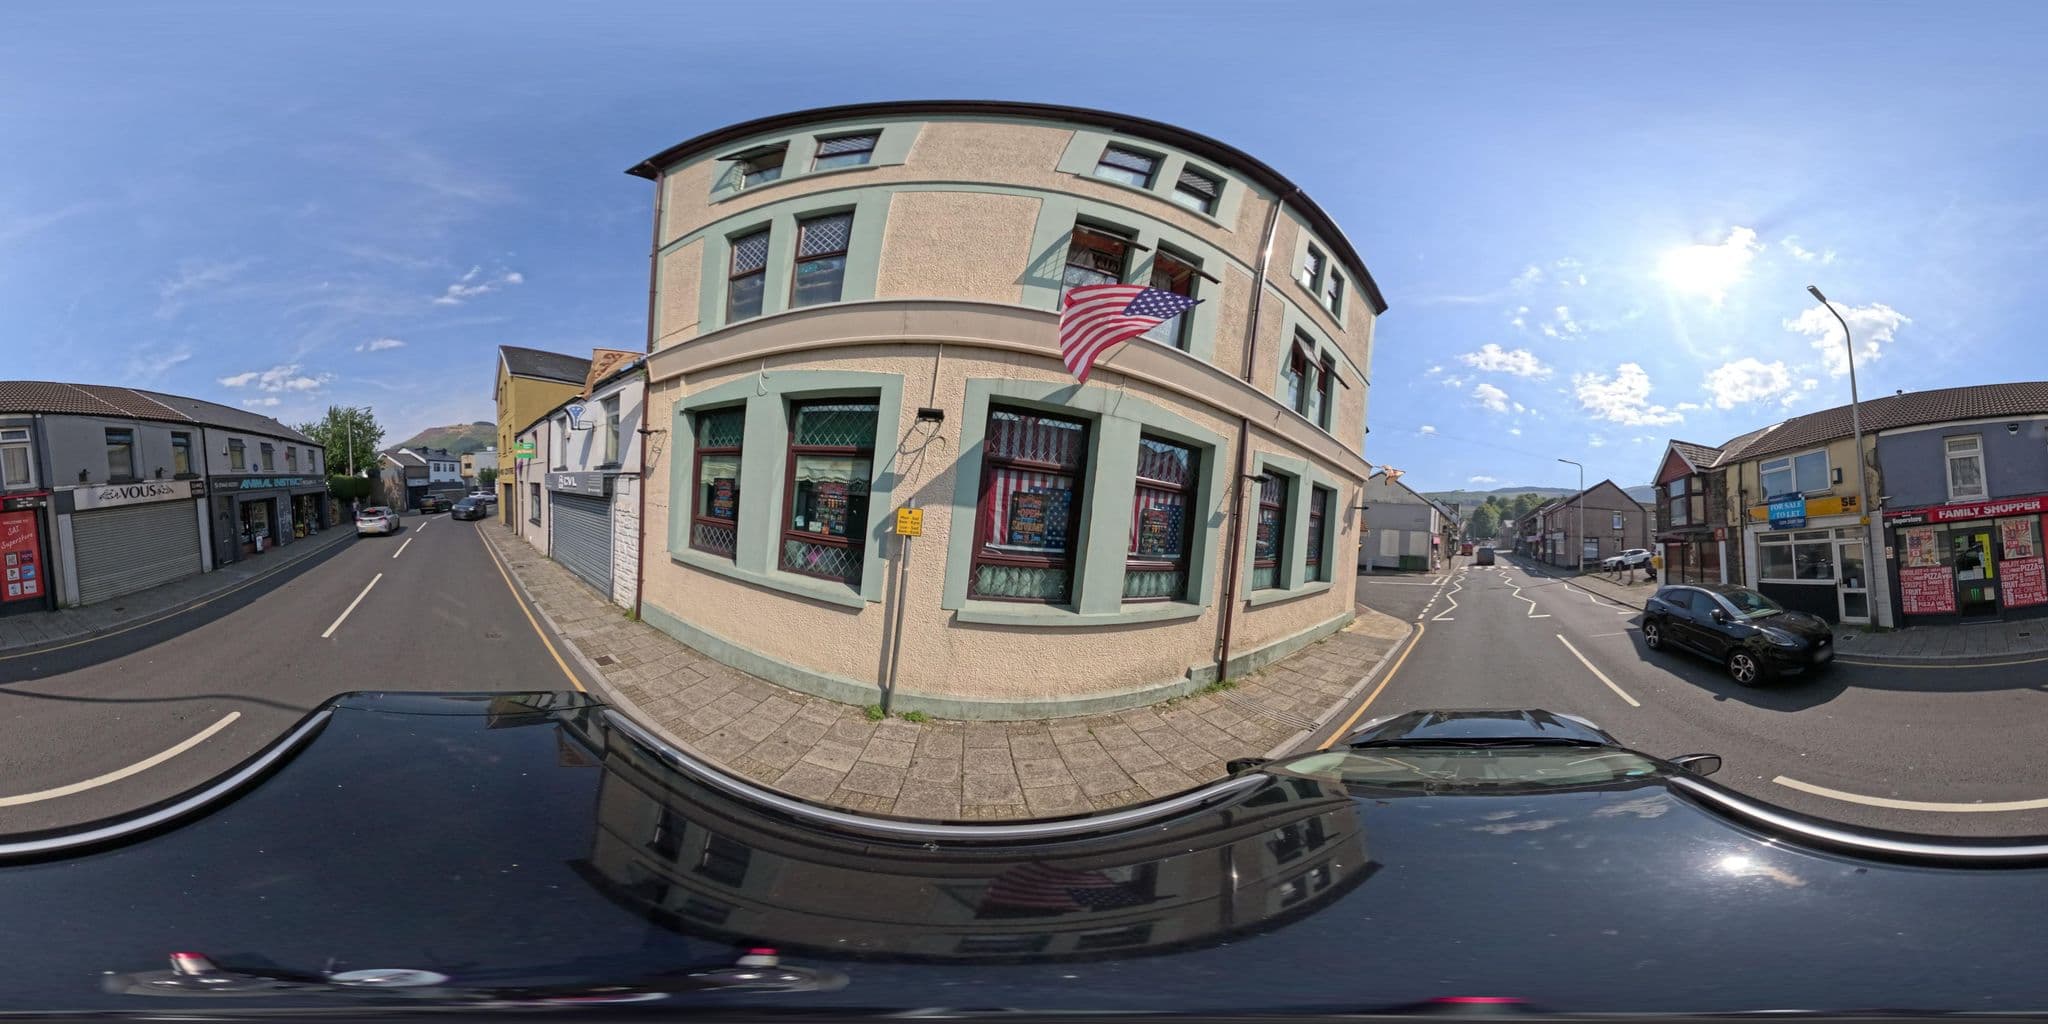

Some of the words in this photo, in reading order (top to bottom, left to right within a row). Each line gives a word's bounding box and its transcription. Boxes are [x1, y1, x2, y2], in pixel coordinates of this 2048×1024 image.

[240, 479, 274, 490] ANIMAL
[120, 485, 157, 499] VOUS
[1769, 503, 1785, 512] FOR
[1785, 501, 1803, 509] SALE
[1841, 496, 1857, 507] SE
[1787, 509, 1801, 518] LET
[1938, 507, 1980, 519] FAMILY
[1983, 501, 2041, 515] SHOPPER
[1892, 515, 1923, 526] Superstore
[2020, 562, 2039, 572] PIZZA
[1923, 572, 1942, 581] PIZZA
